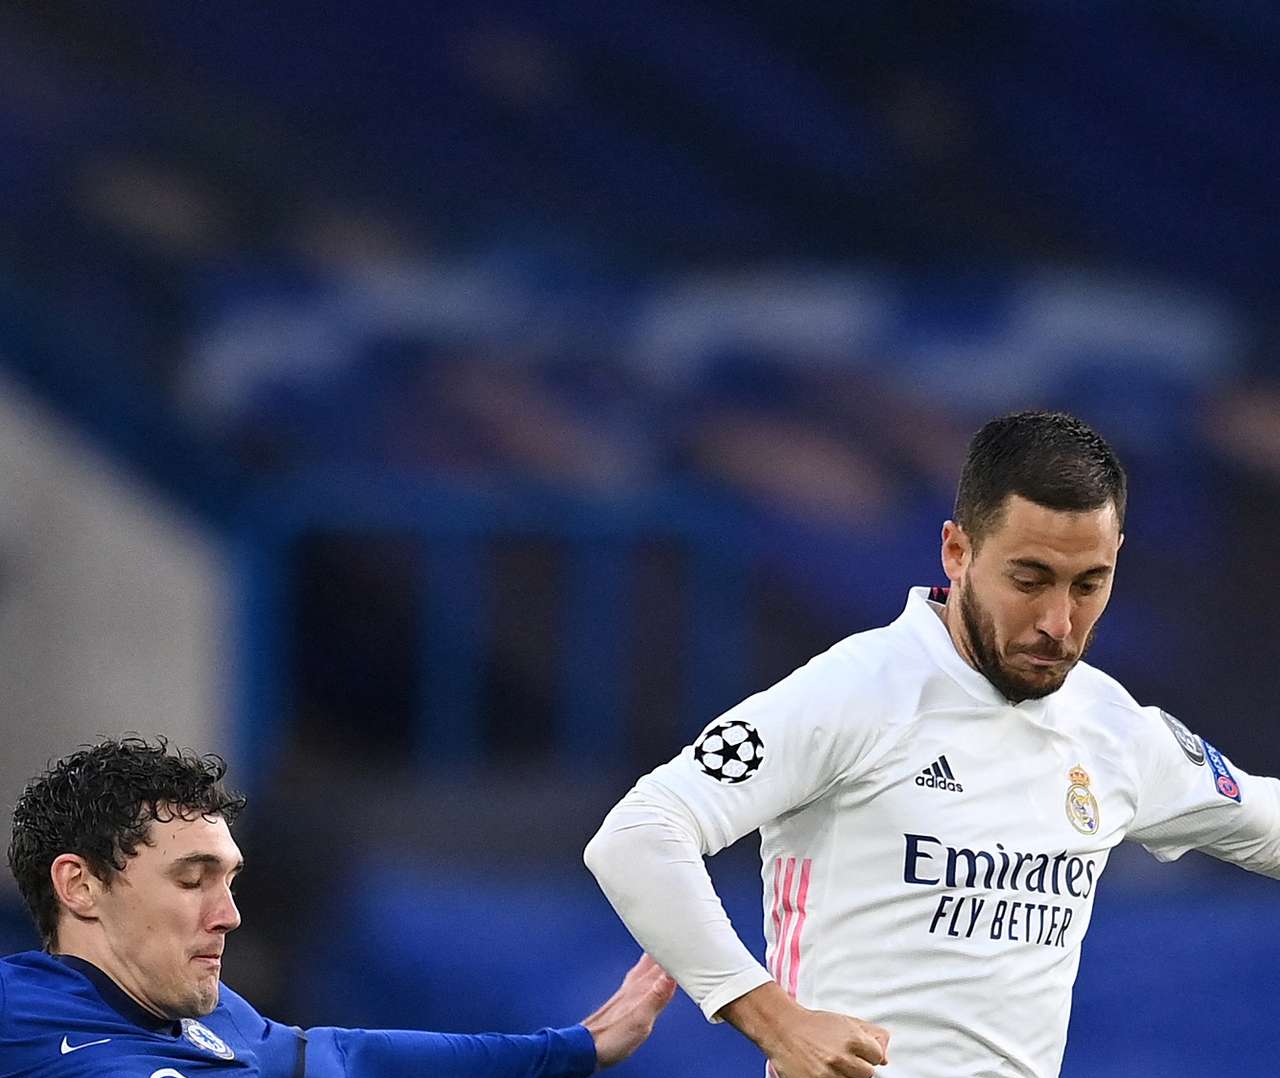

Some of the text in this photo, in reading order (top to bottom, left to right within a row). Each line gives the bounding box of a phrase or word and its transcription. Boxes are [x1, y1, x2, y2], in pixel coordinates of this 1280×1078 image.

[915, 774, 964, 793] adidas
[903, 833, 1096, 900] Emirates
[928, 895, 1074, 948] FLY BETTER
